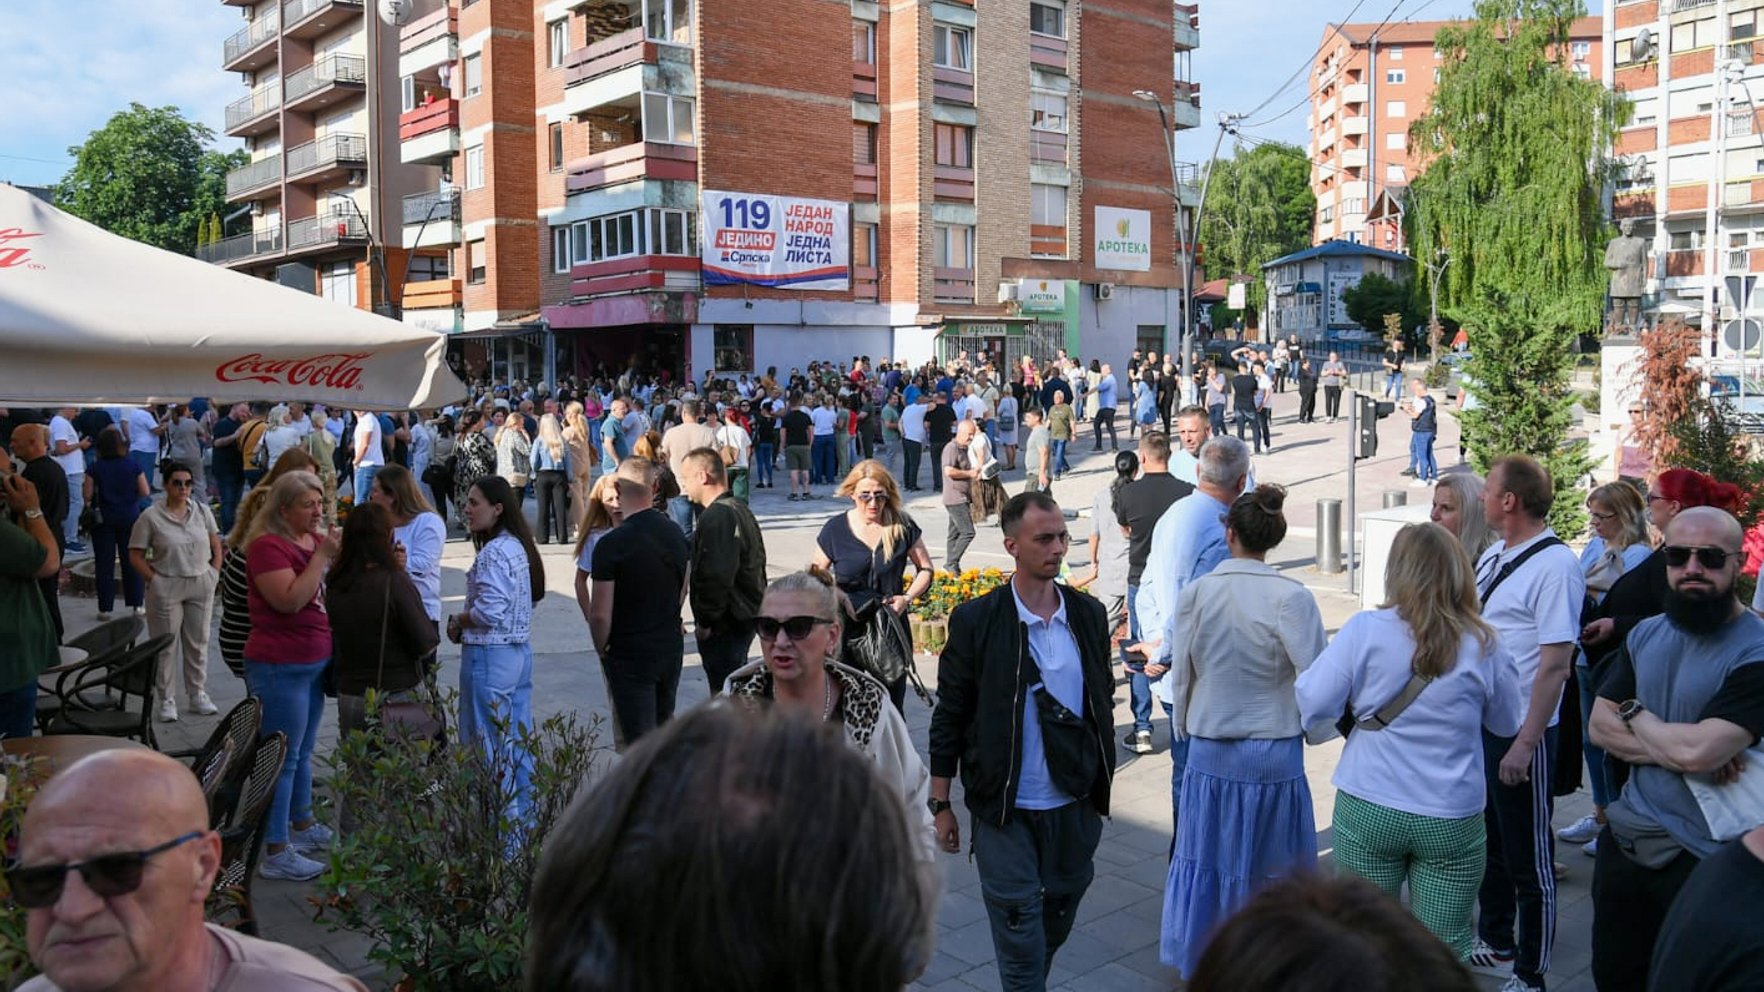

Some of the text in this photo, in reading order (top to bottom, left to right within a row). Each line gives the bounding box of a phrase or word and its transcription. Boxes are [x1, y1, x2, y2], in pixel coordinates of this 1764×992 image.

[719, 198, 770, 229] 119
[785, 204, 833, 220] ЈЕДАН
[785, 220, 834, 236] НАРОД
[718, 231, 773, 249] ЈЕДИНО
[785, 235, 831, 250] ЈЕДНА
[1098, 240, 1149, 255] APOTEKA
[730, 251, 770, 264] Српска
[785, 250, 832, 264] ЛИСТА
[970, 325, 1004, 333] APOTEKA
